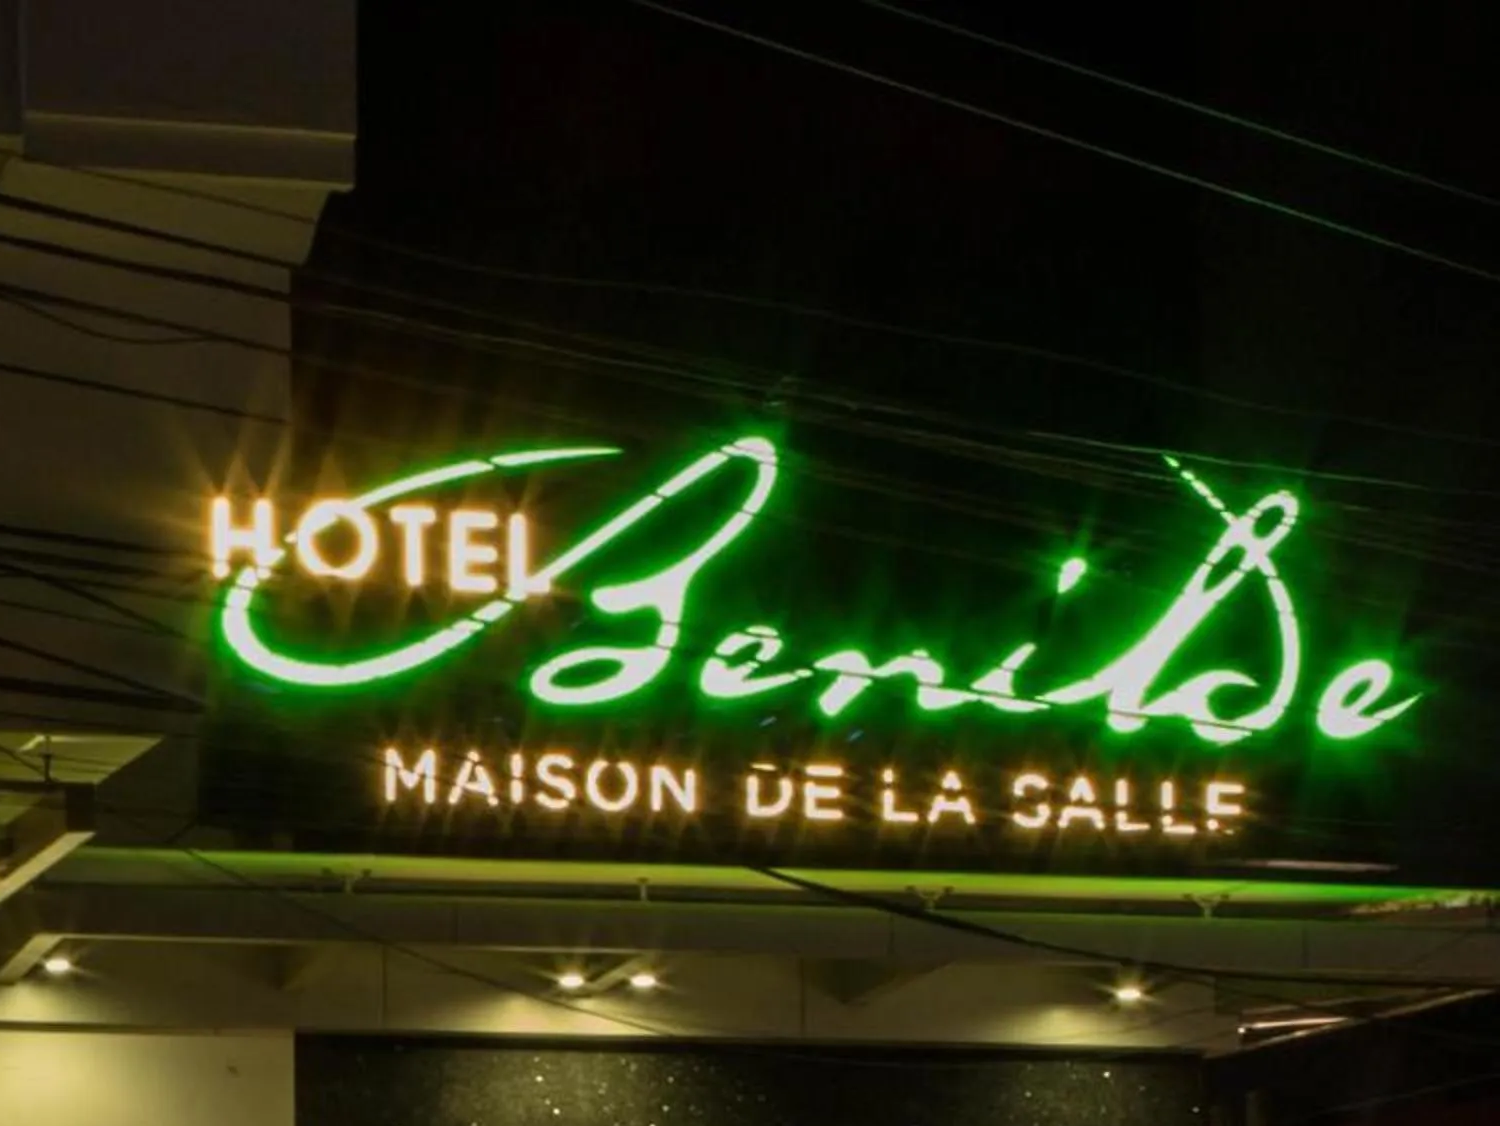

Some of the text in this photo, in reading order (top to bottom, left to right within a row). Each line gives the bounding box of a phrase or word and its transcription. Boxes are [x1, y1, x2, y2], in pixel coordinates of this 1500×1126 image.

[209, 495, 552, 596] HOTEL
[220, 436, 1424, 745] Benilde
[383, 747, 1246, 834] MAISON DE LA SALLE
